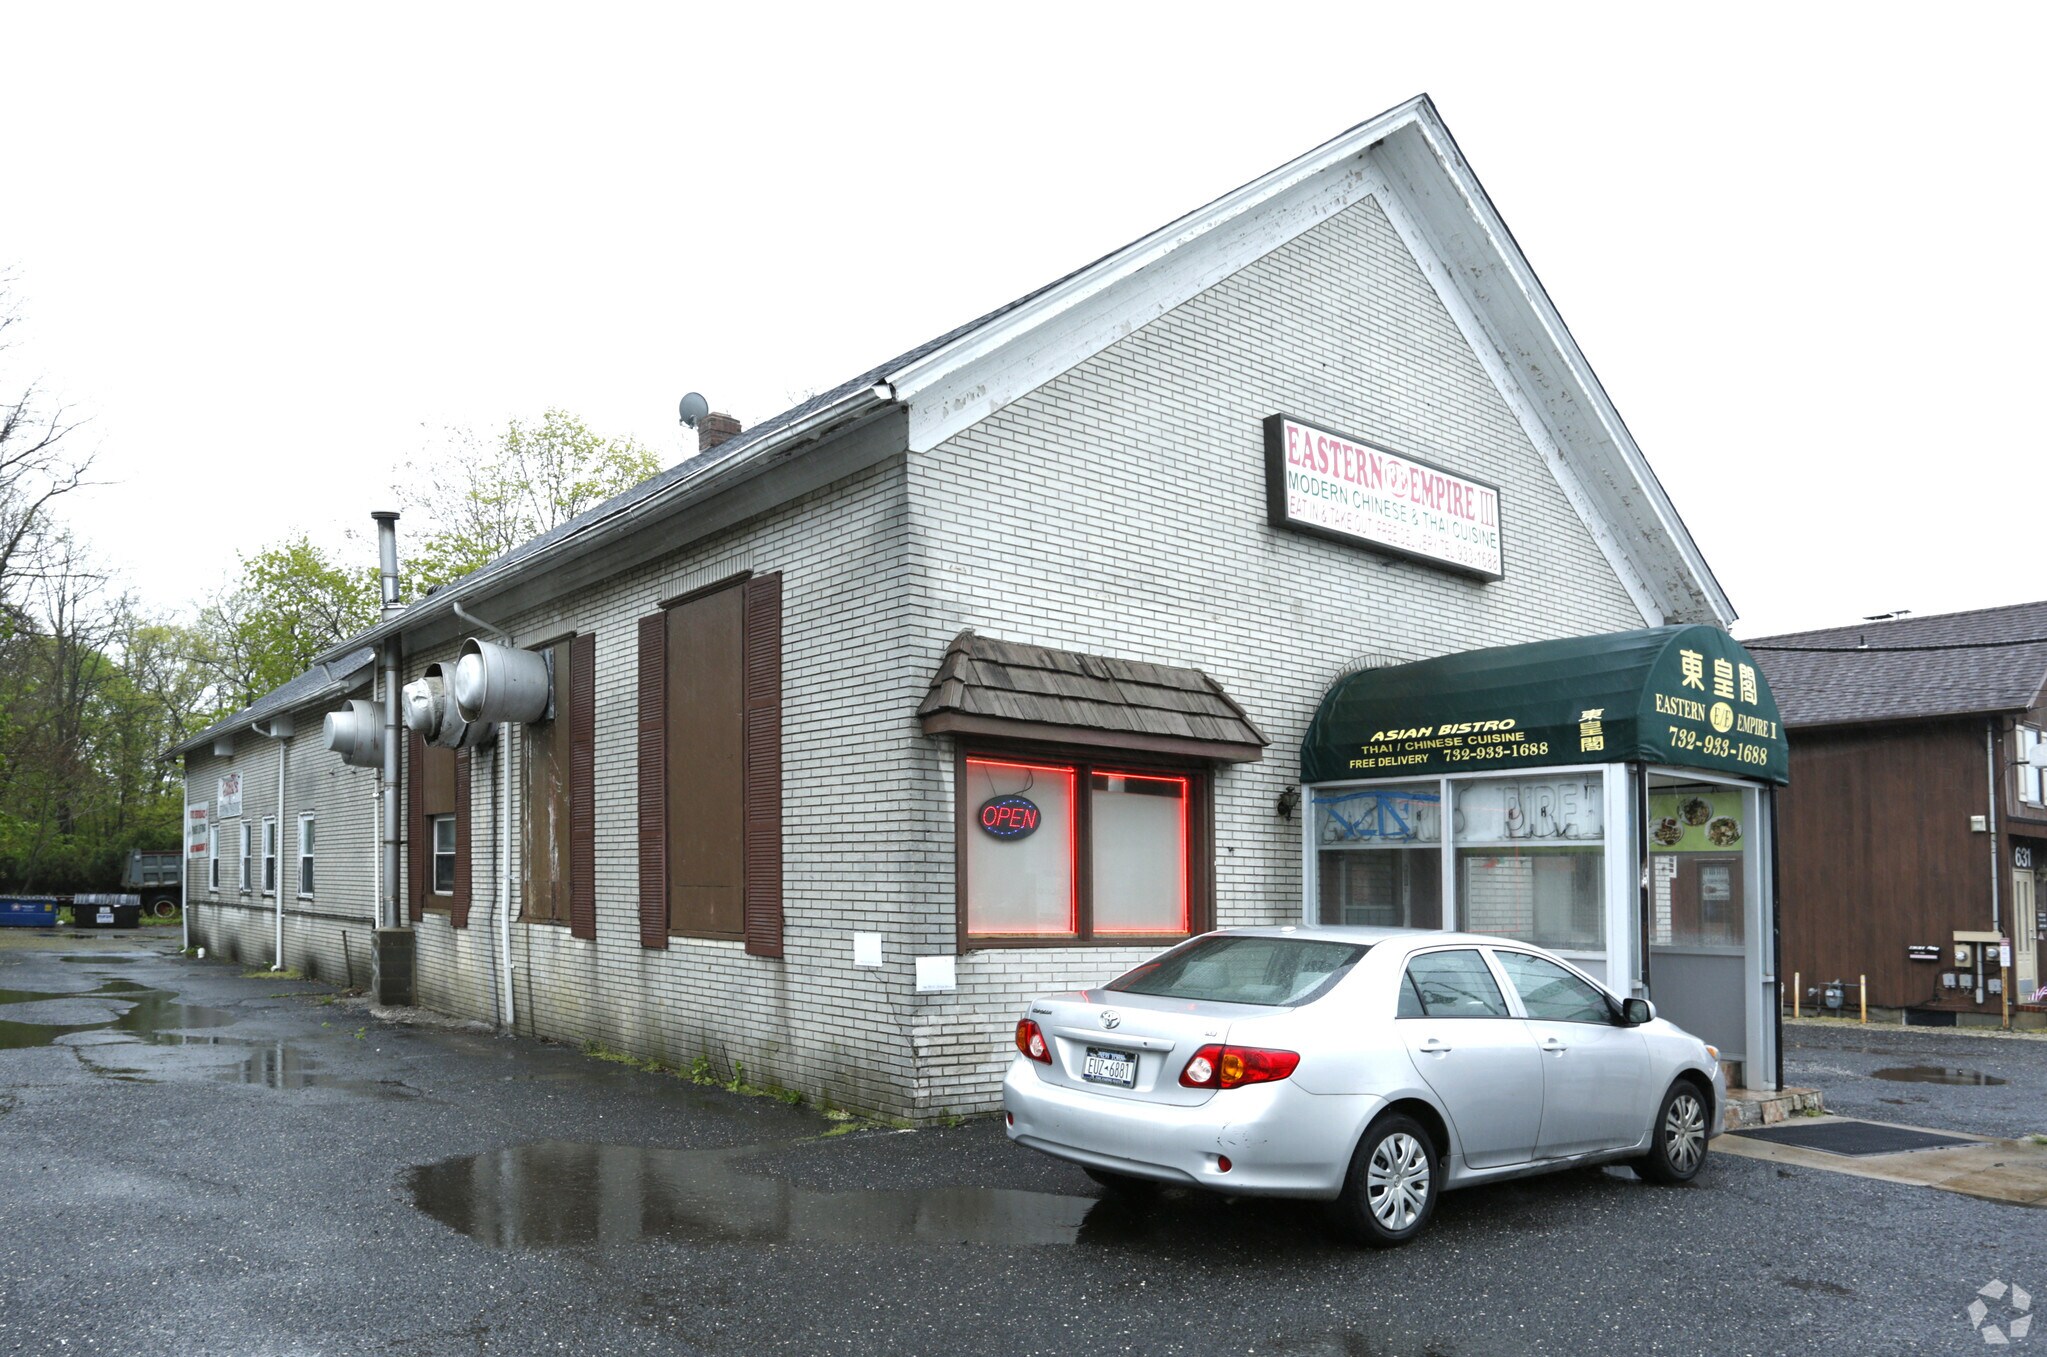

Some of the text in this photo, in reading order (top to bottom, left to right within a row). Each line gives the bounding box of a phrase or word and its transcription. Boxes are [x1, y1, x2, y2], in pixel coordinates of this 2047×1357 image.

[1286, 425, 1383, 491] EASTERN
[1409, 466, 1475, 521] EMPIRE
[1479, 490, 1495, 528] III
[1288, 470, 1497, 549] MODERN CHINESE & THAI CUISINE
[1290, 495, 1307, 518] EAT
[1309, 502, 1319, 520] IN
[1322, 504, 1327, 523] &
[1330, 507, 1352, 531] TAKE
[1355, 514, 1373, 535] OUT
[1655, 693, 1706, 722] EASTERN
[1736, 713, 1768, 738] EMPIRE
[1361, 744, 1393, 755] THAI
[1404, 736, 1463, 751] CHINESE
[1467, 731, 1526, 745] CUISINE
[1370, 718, 1516, 743] ASIAN BISTRO
[1349, 741, 1549, 769] FREE DELIVERY 732-933-1688
[1669, 725, 1768, 766] 732-933-1688
[982, 805, 1037, 829] OPEN
[2014, 846, 2032, 868] 631
[1109, 1062, 1129, 1079] 6881
